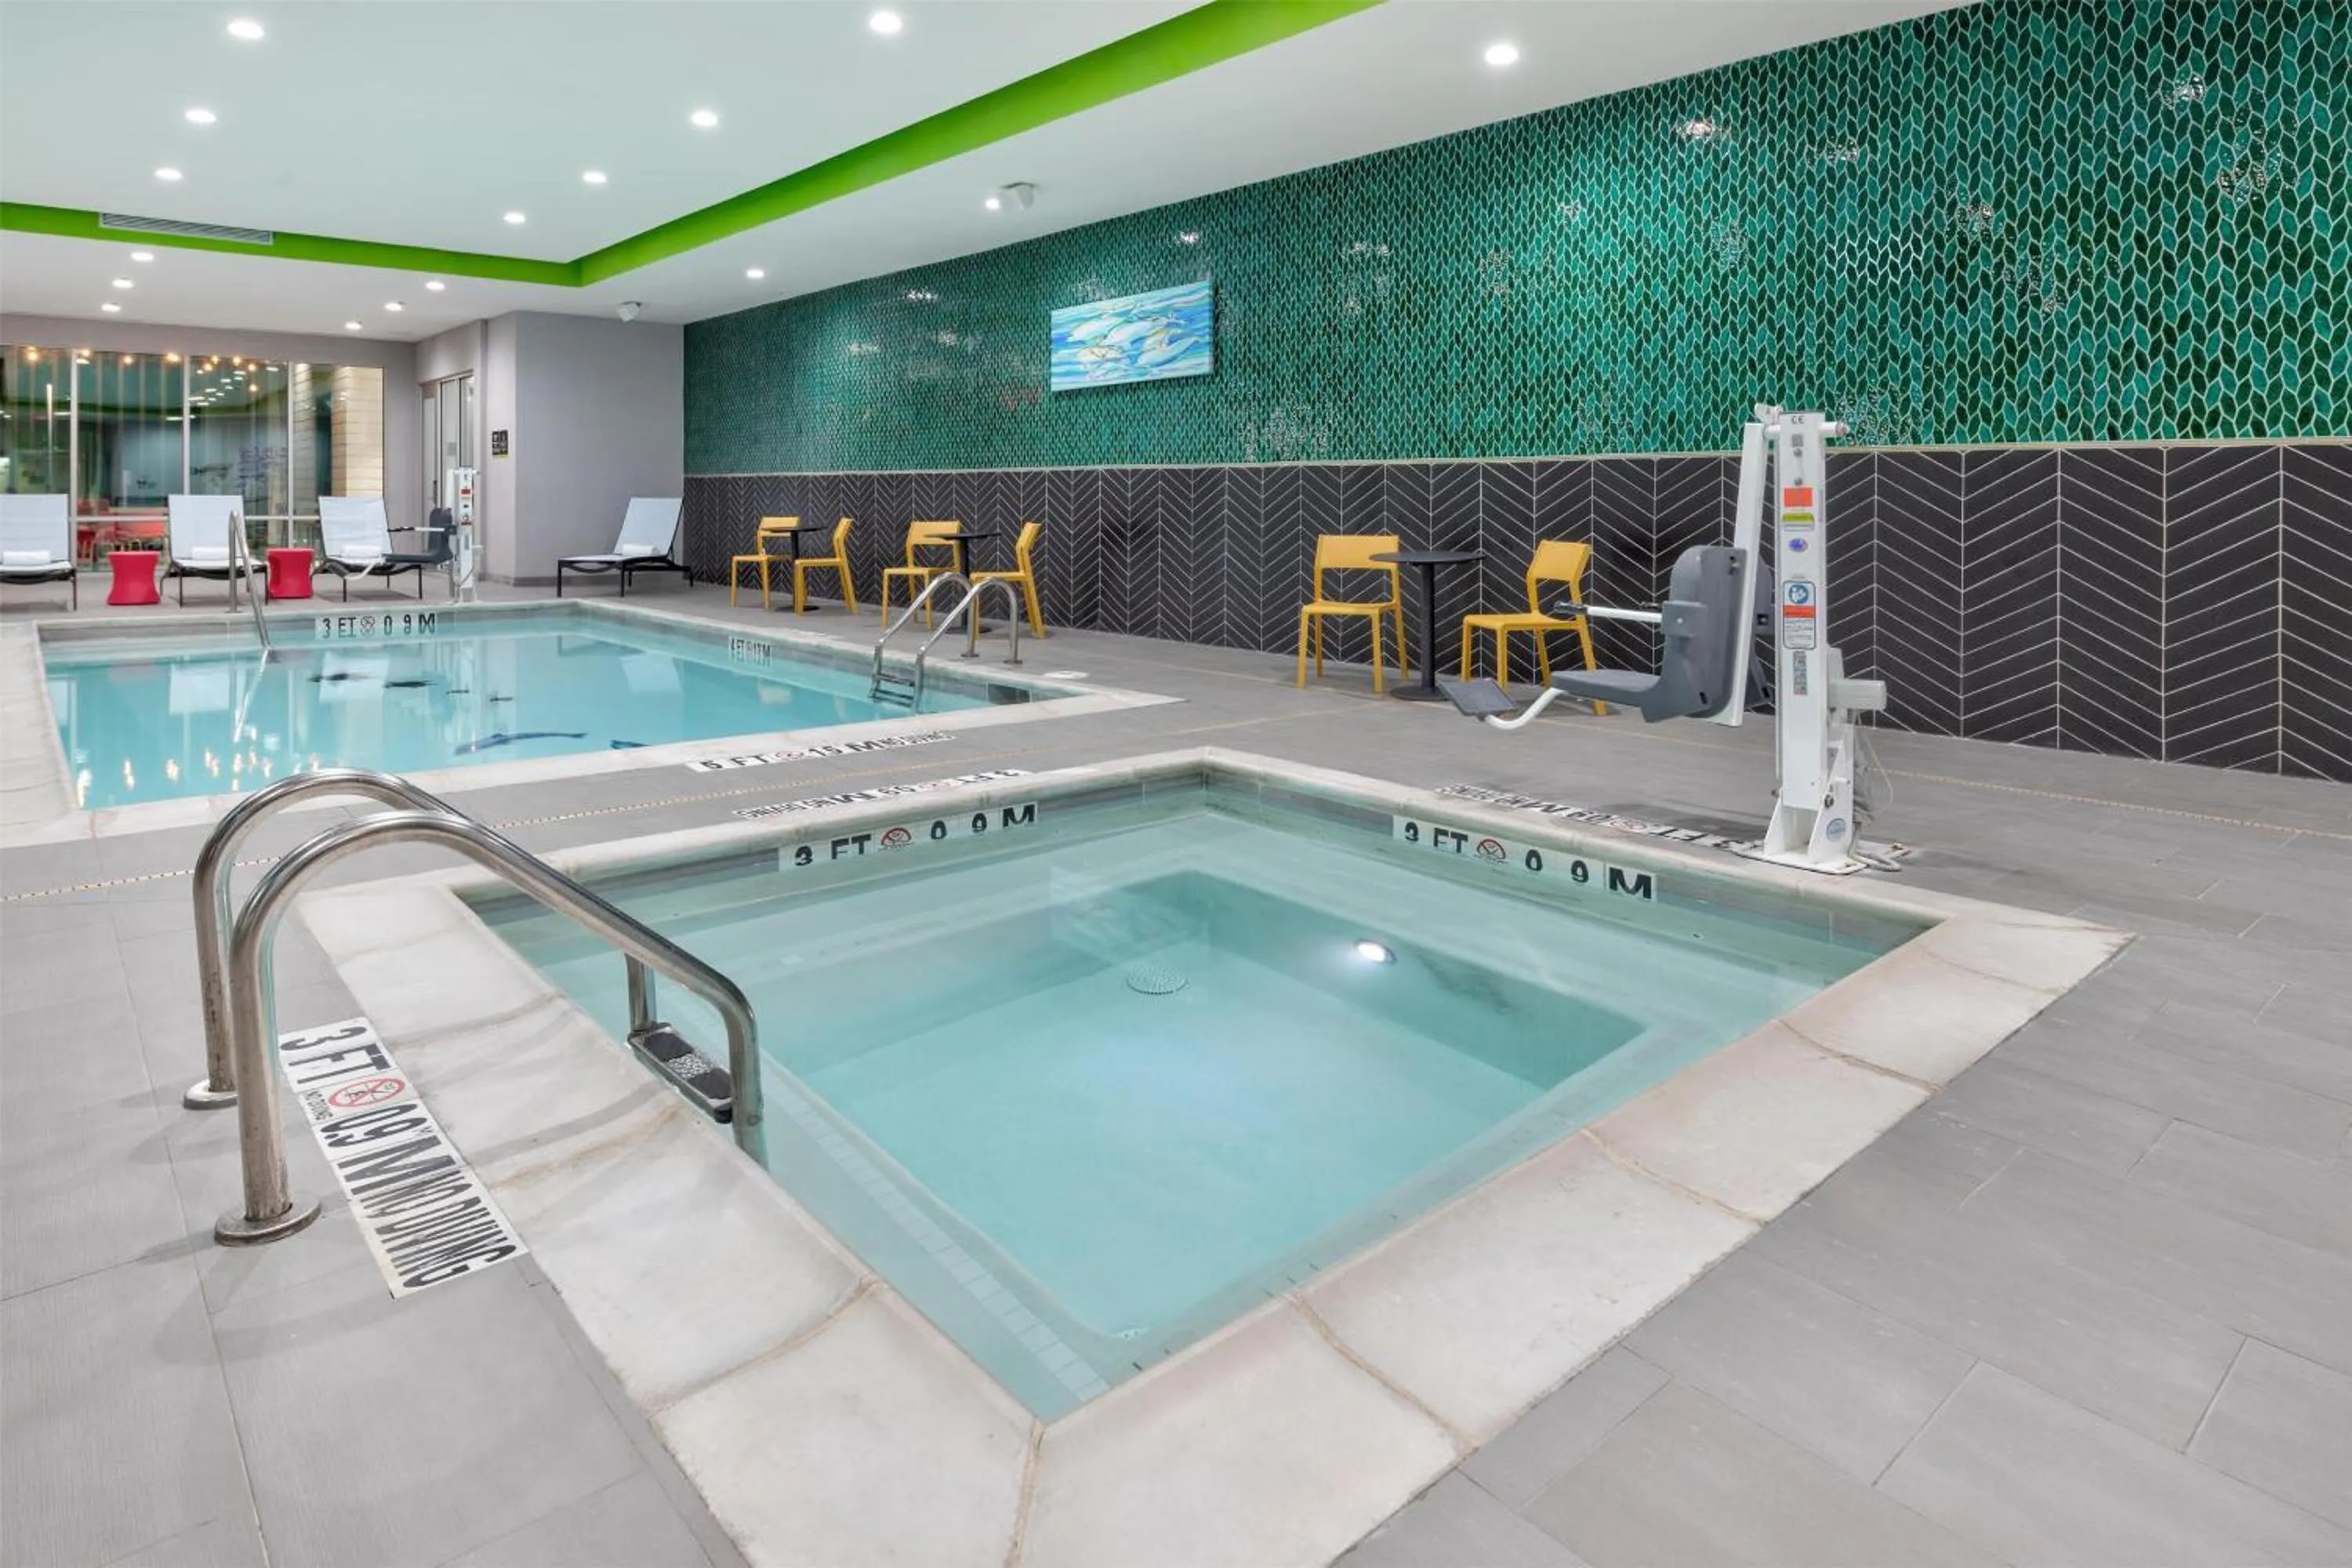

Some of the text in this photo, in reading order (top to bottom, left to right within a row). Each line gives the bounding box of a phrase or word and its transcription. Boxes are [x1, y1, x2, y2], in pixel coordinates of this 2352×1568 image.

[795, 846, 813, 866] 3
[831, 834, 871, 859] FT
[1003, 804, 1034, 828] M
[1404, 822, 1419, 843] 3
[1433, 827, 1468, 854] FT
[1609, 867, 1652, 899] M
[280, 1026, 366, 1051] 3
[289, 1044, 390, 1085] FT
[337, 1135, 456, 1196] M
[376, 1196, 517, 1288] DIVING
